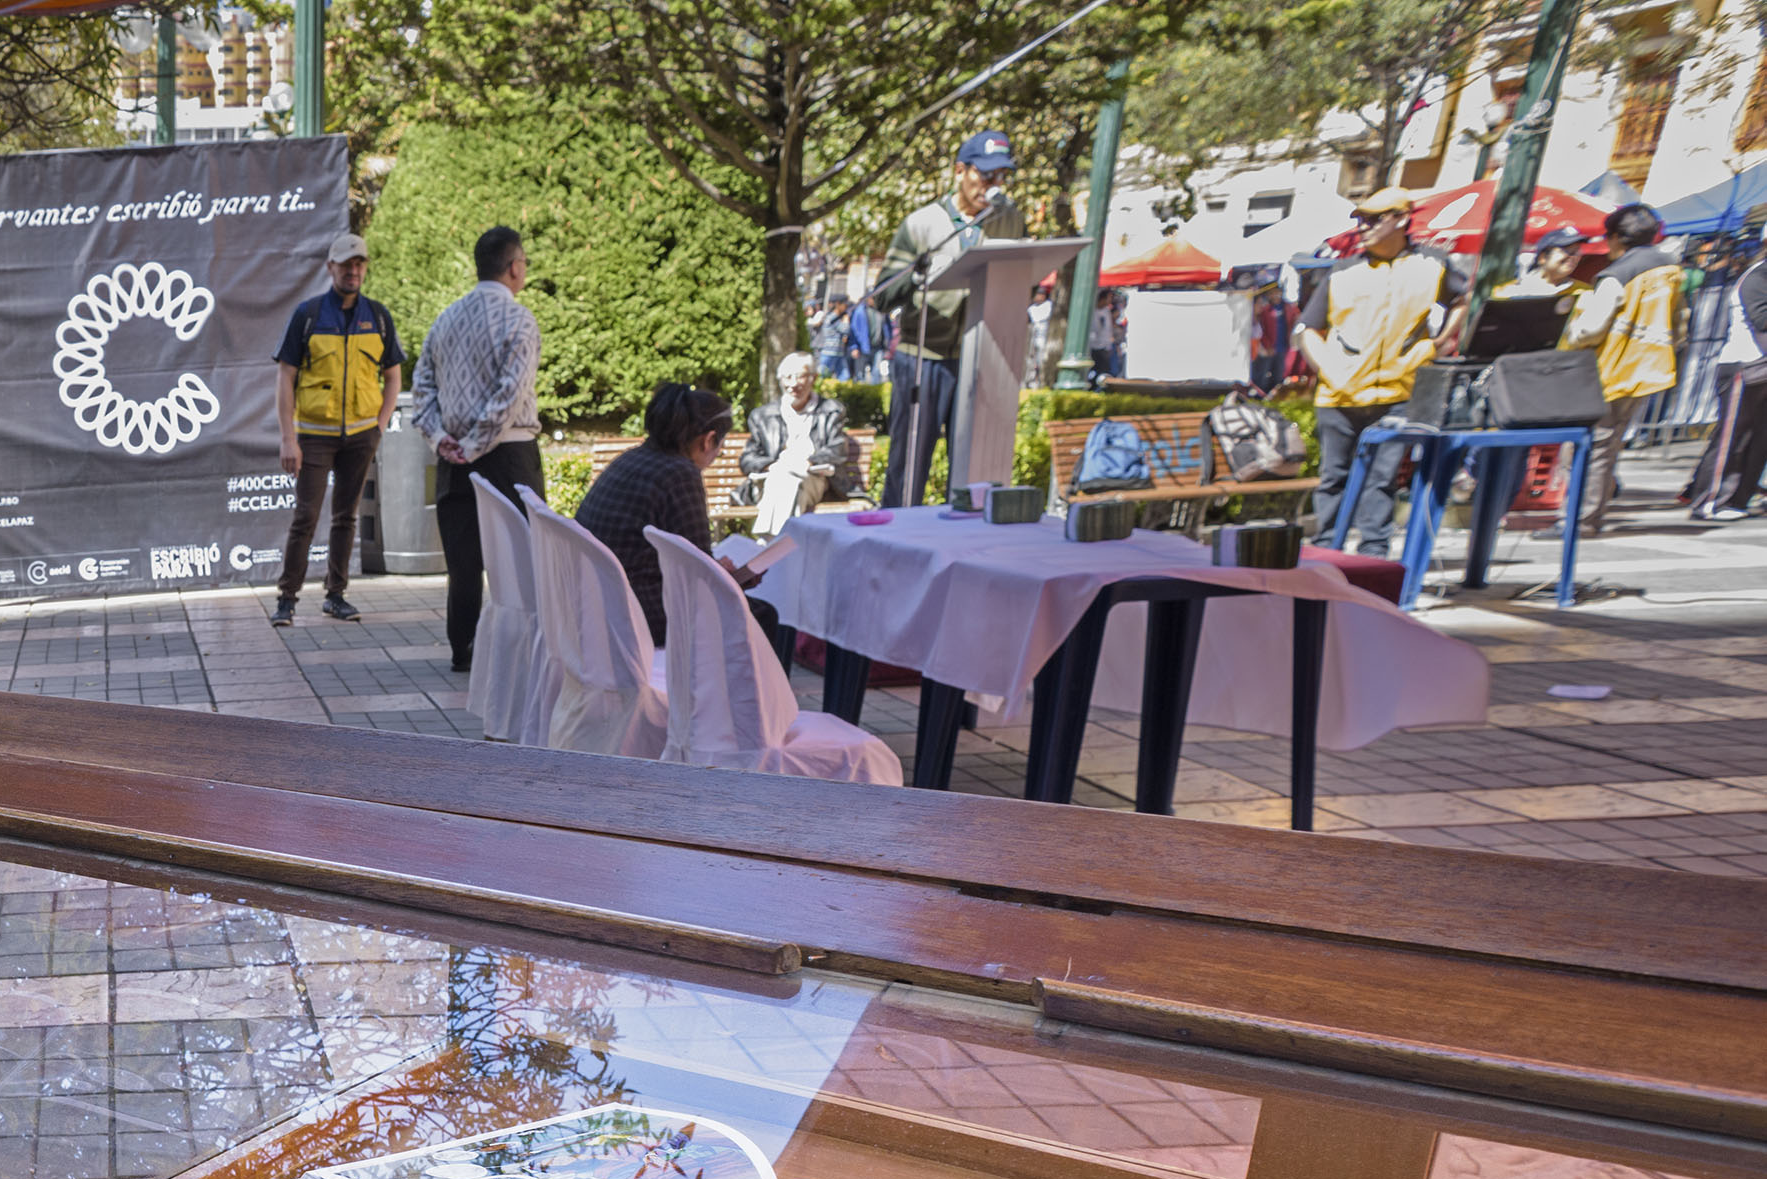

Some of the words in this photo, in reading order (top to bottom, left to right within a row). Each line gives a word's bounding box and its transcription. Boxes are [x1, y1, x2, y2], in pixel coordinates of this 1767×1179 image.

[106, 190, 203, 223] escribió
[198, 195, 271, 225] para
[277, 187, 316, 213] ti...
[150, 542, 221, 567] ESCRIBIÓ
[151, 562, 194, 580] PARA
[196, 561, 212, 577] TI
